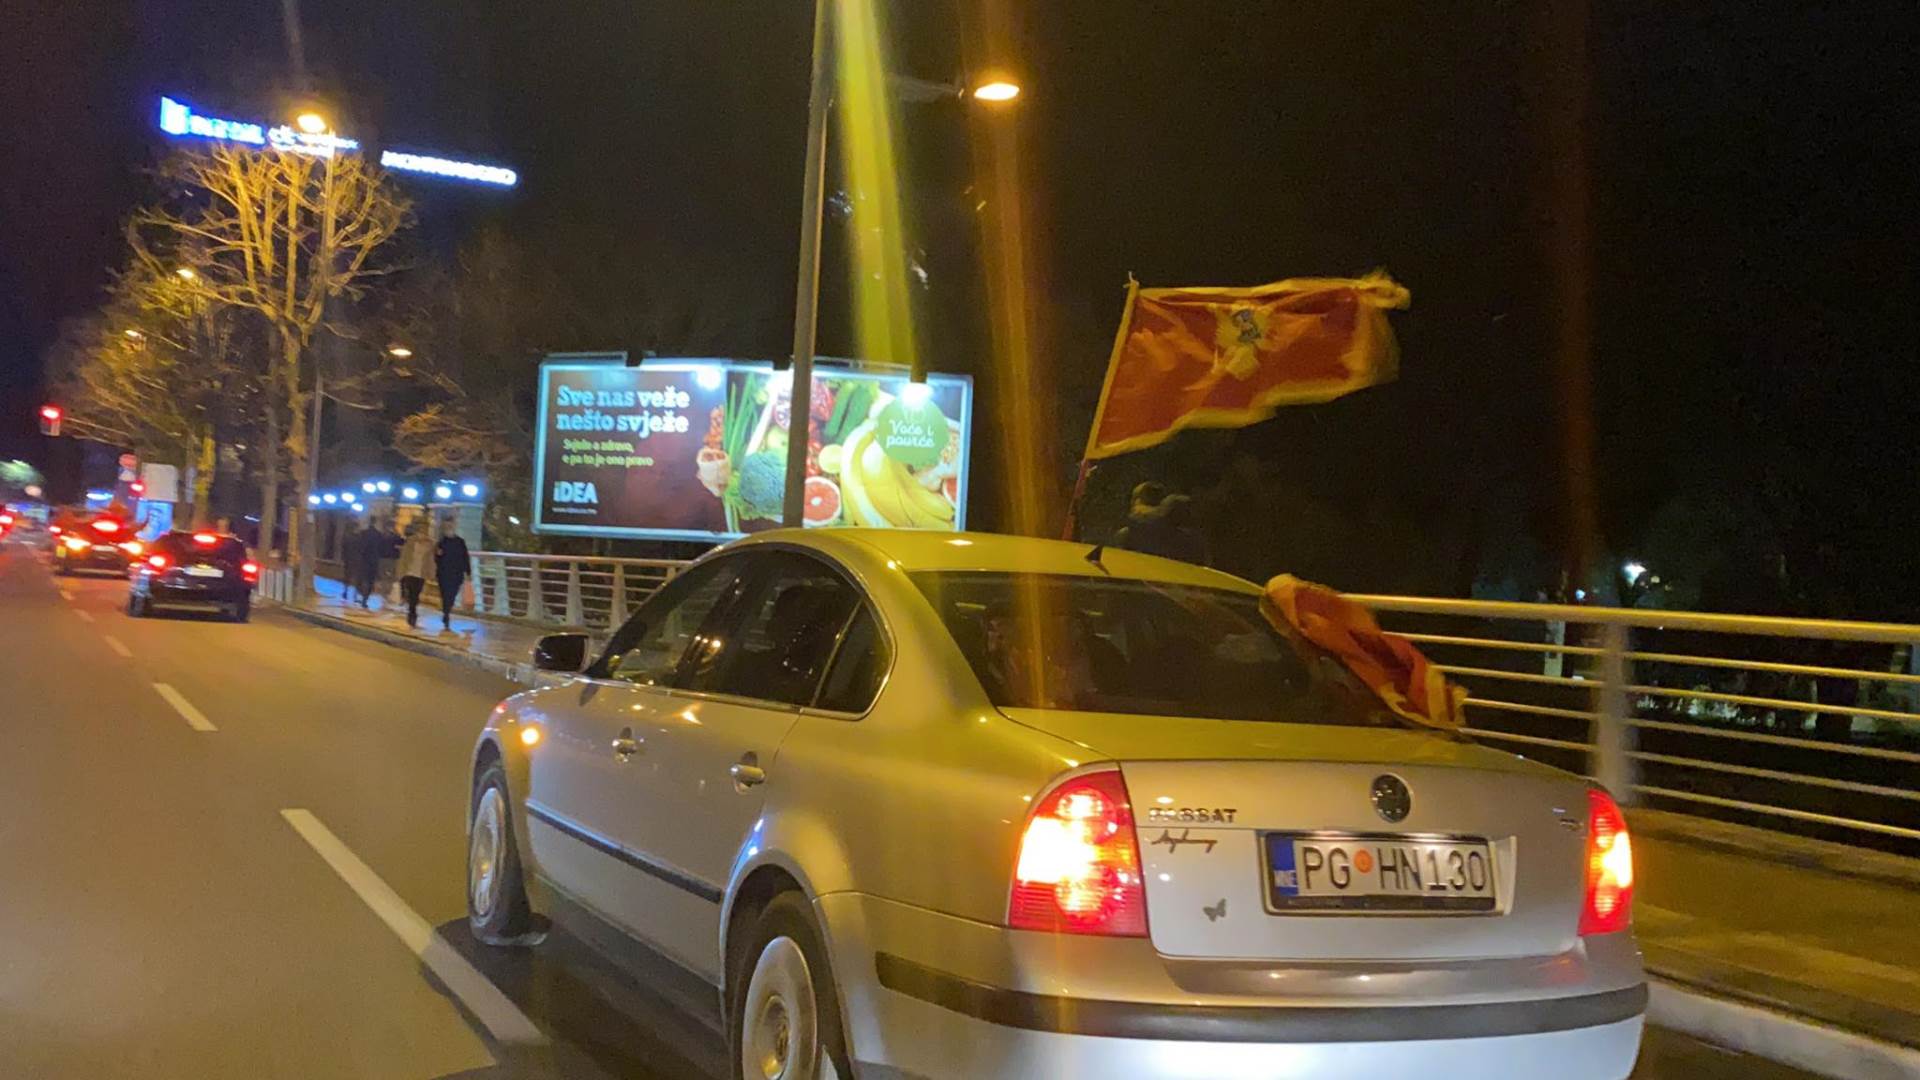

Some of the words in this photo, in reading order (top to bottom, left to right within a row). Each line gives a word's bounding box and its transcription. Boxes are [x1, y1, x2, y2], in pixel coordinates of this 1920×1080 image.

[557, 385, 594, 407] Sve
[597, 390, 635, 408] nas
[637, 385, 690, 408] veže
[556, 408, 615, 431] nešto
[616, 410, 689, 438] svježe
[1149, 808, 1237, 823] PASSAT
[1302, 846, 1351, 890] PG
